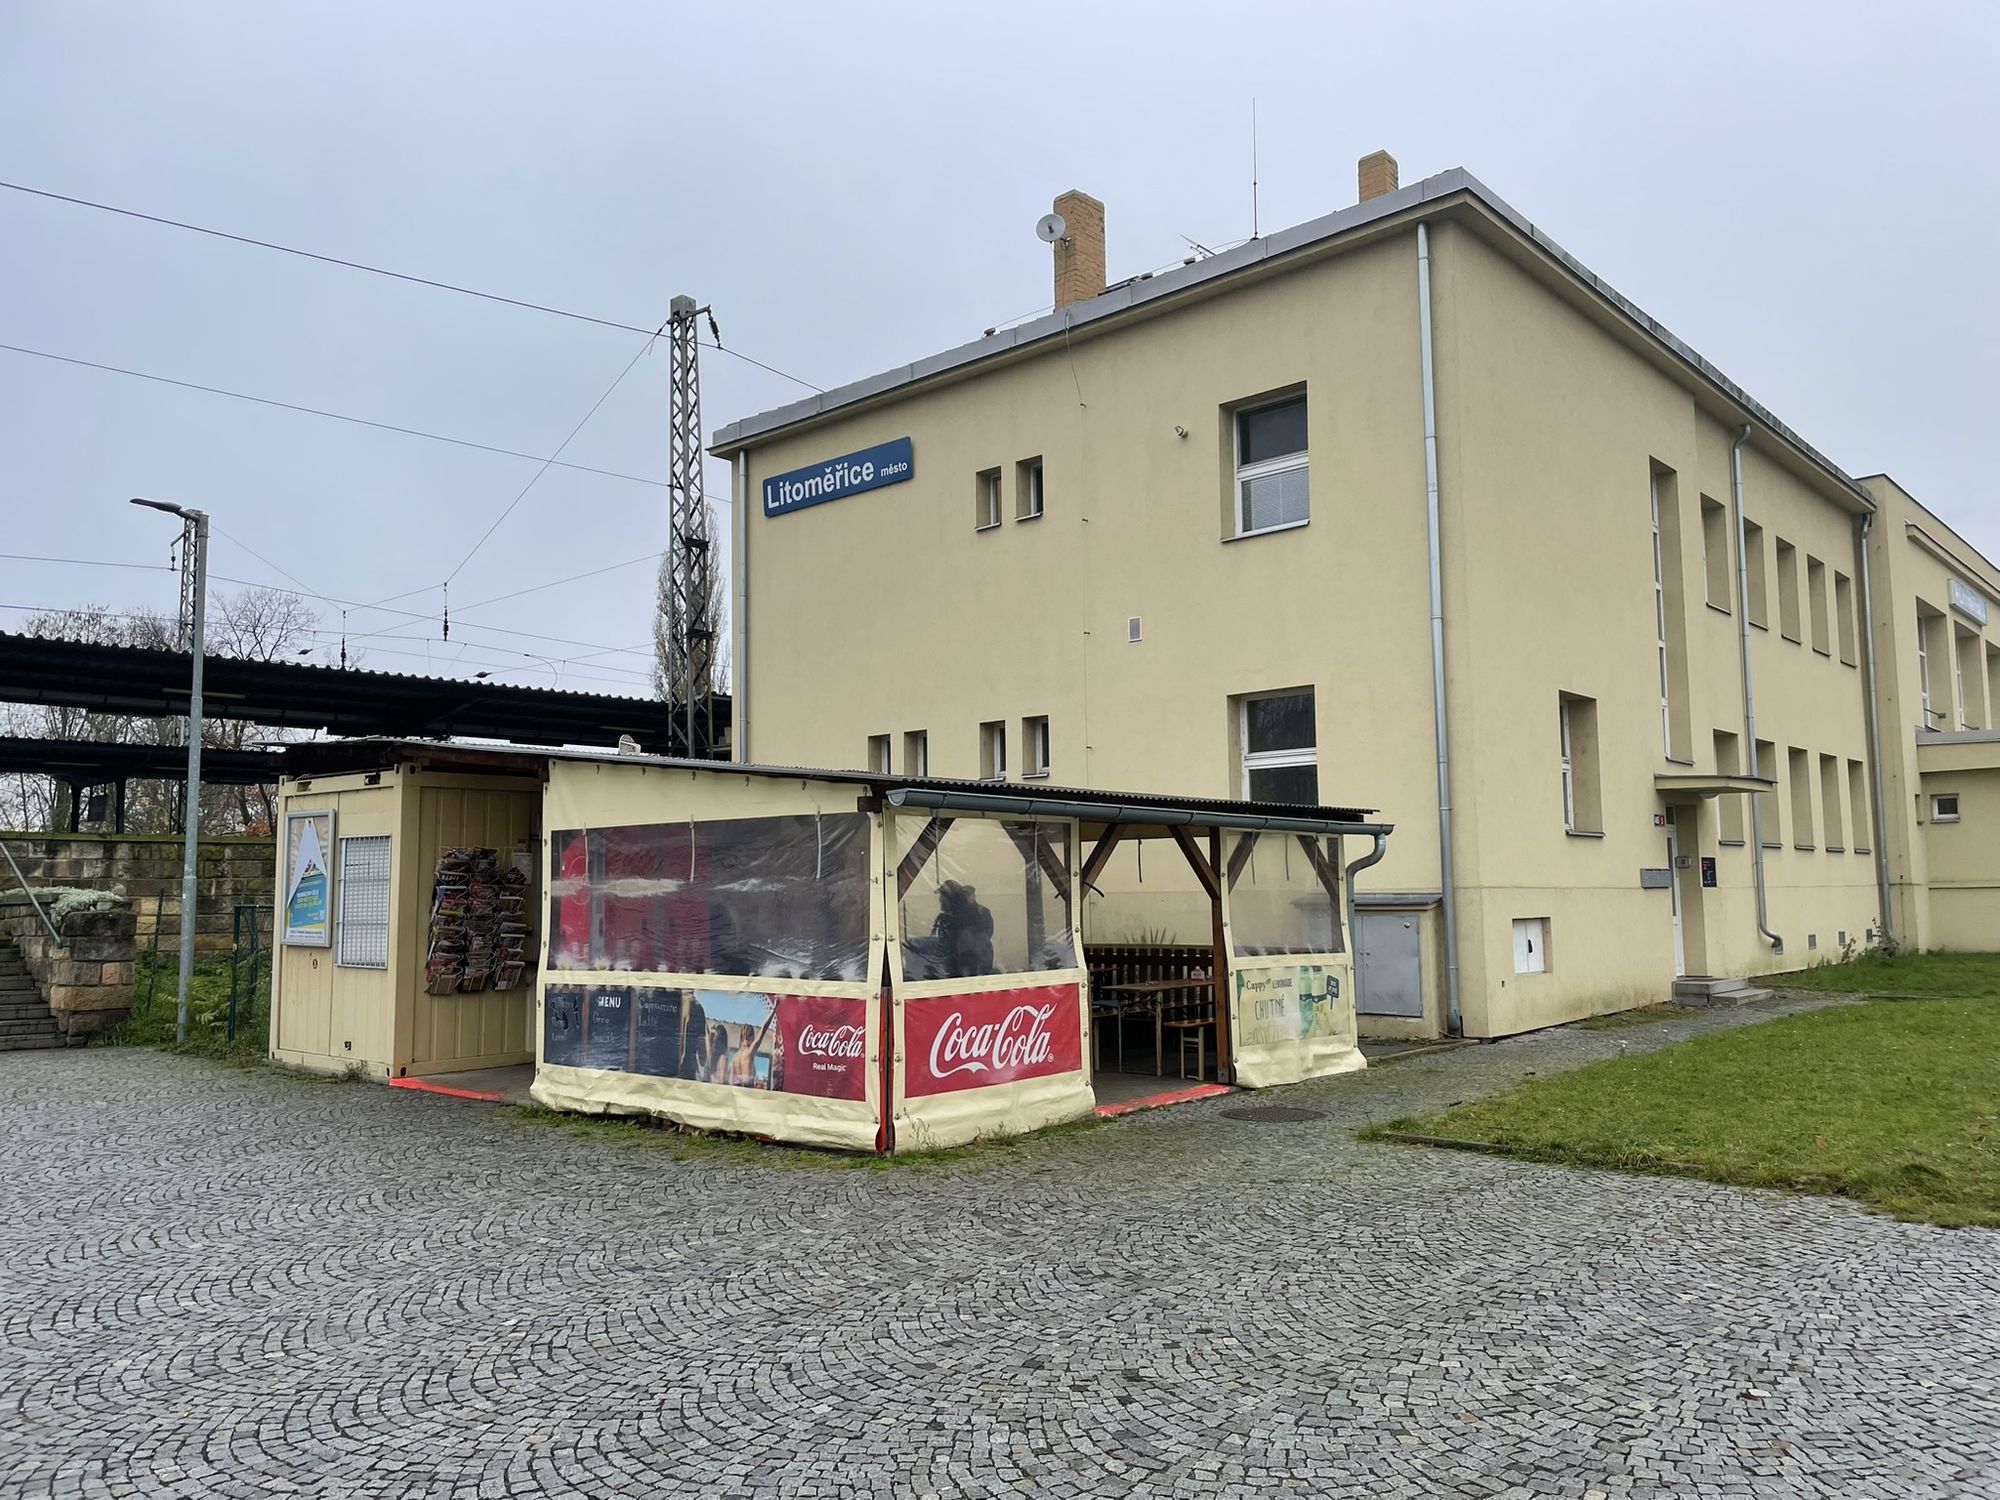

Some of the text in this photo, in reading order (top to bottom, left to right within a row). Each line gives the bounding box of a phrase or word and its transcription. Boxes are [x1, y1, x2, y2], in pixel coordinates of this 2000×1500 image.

[767, 461, 908, 509] Litoměřice město
[1246, 980, 1266, 993] Cappy
[597, 996, 622, 1009] MENU
[798, 1024, 867, 1058] Coca-Cola
[929, 1002, 1058, 1079] Coca-Cola
[812, 1062, 847, 1073] Real Magic
